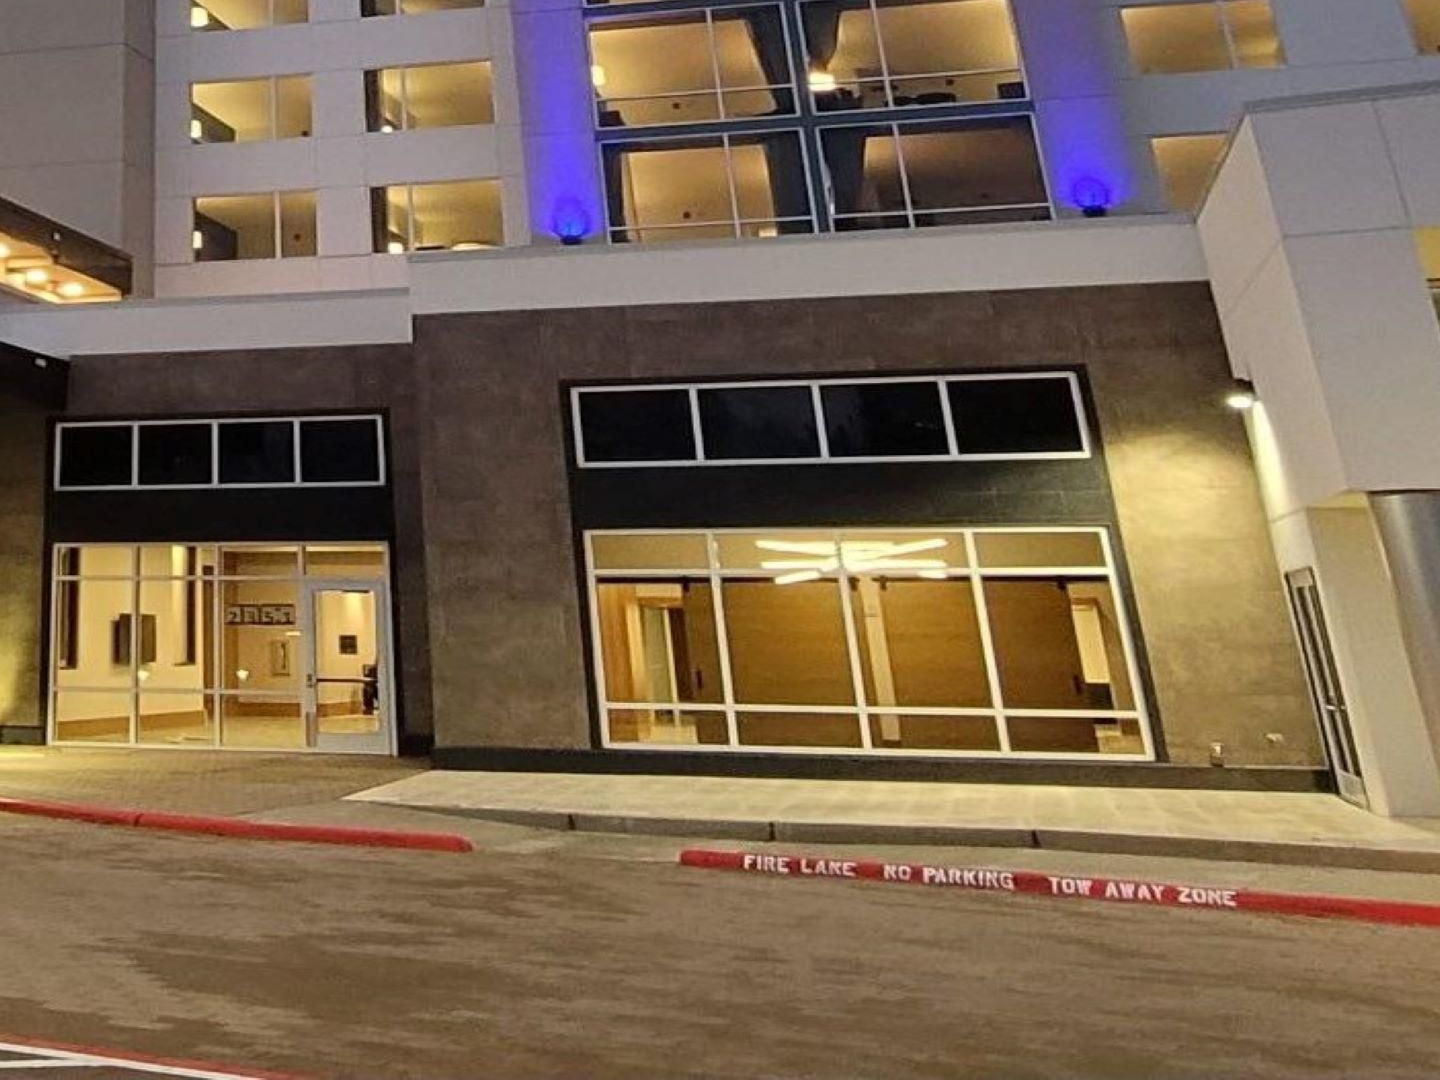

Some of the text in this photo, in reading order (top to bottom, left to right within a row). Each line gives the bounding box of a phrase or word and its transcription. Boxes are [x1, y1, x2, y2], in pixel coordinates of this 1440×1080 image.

[743, 854, 1237, 907] FIRE LANE NO PARKING TOW AWAY ZONE
